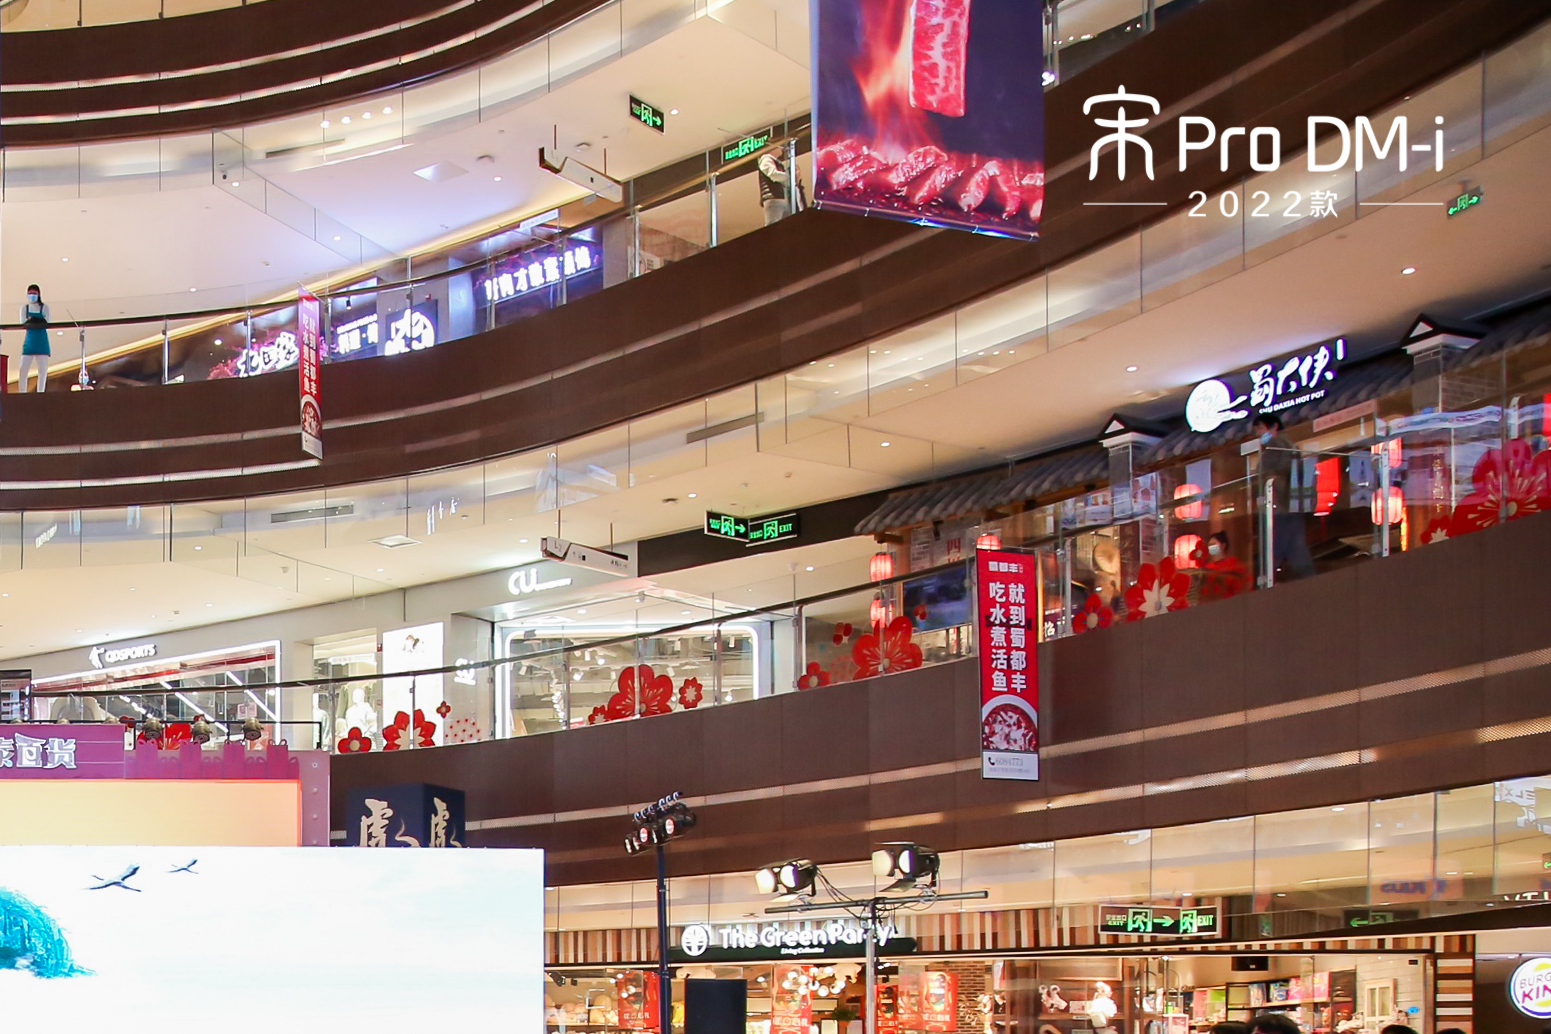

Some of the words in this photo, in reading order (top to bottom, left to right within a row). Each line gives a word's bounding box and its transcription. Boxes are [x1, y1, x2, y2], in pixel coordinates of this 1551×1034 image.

[1295, 394, 1311, 406] HOT
[1310, 389, 1326, 401] POT
[778, 523, 793, 533] EXIT
[988, 582, 1008, 692] 吃水煮活鱼
[1008, 582, 1027, 693] 就到蜀都丰
[1197, 914, 1214, 927] EXIT
[718, 927, 759, 950] The
[760, 925, 828, 949] Green
[829, 922, 891, 946] Pary
